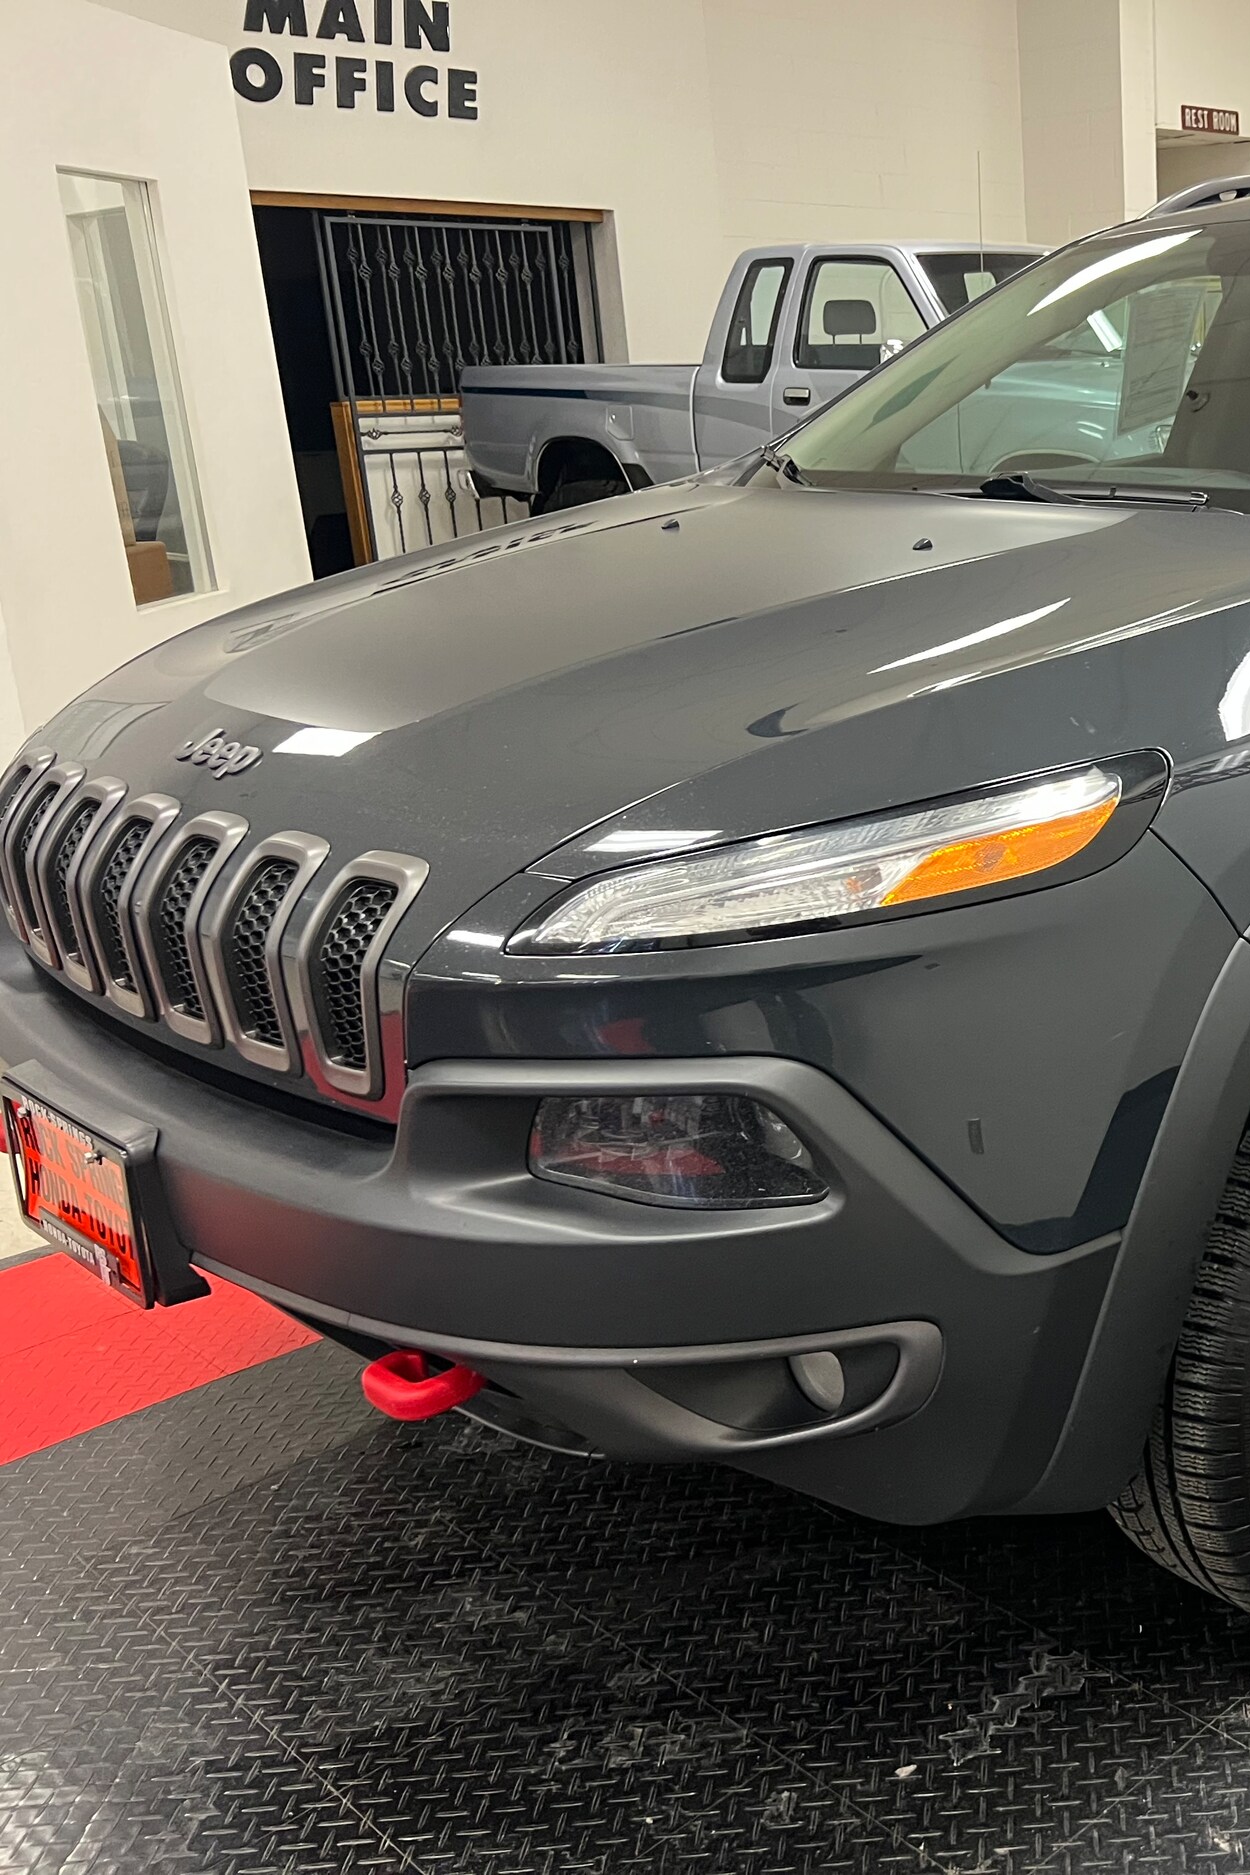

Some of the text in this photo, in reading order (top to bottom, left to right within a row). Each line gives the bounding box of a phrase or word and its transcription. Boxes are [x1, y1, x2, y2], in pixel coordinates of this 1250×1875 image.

[243, 0, 450, 52] MAIN
[229, 47, 478, 120] OFFICE
[1184, 108, 1237, 132] REST ROOM
[175, 728, 263, 780] Jeep
